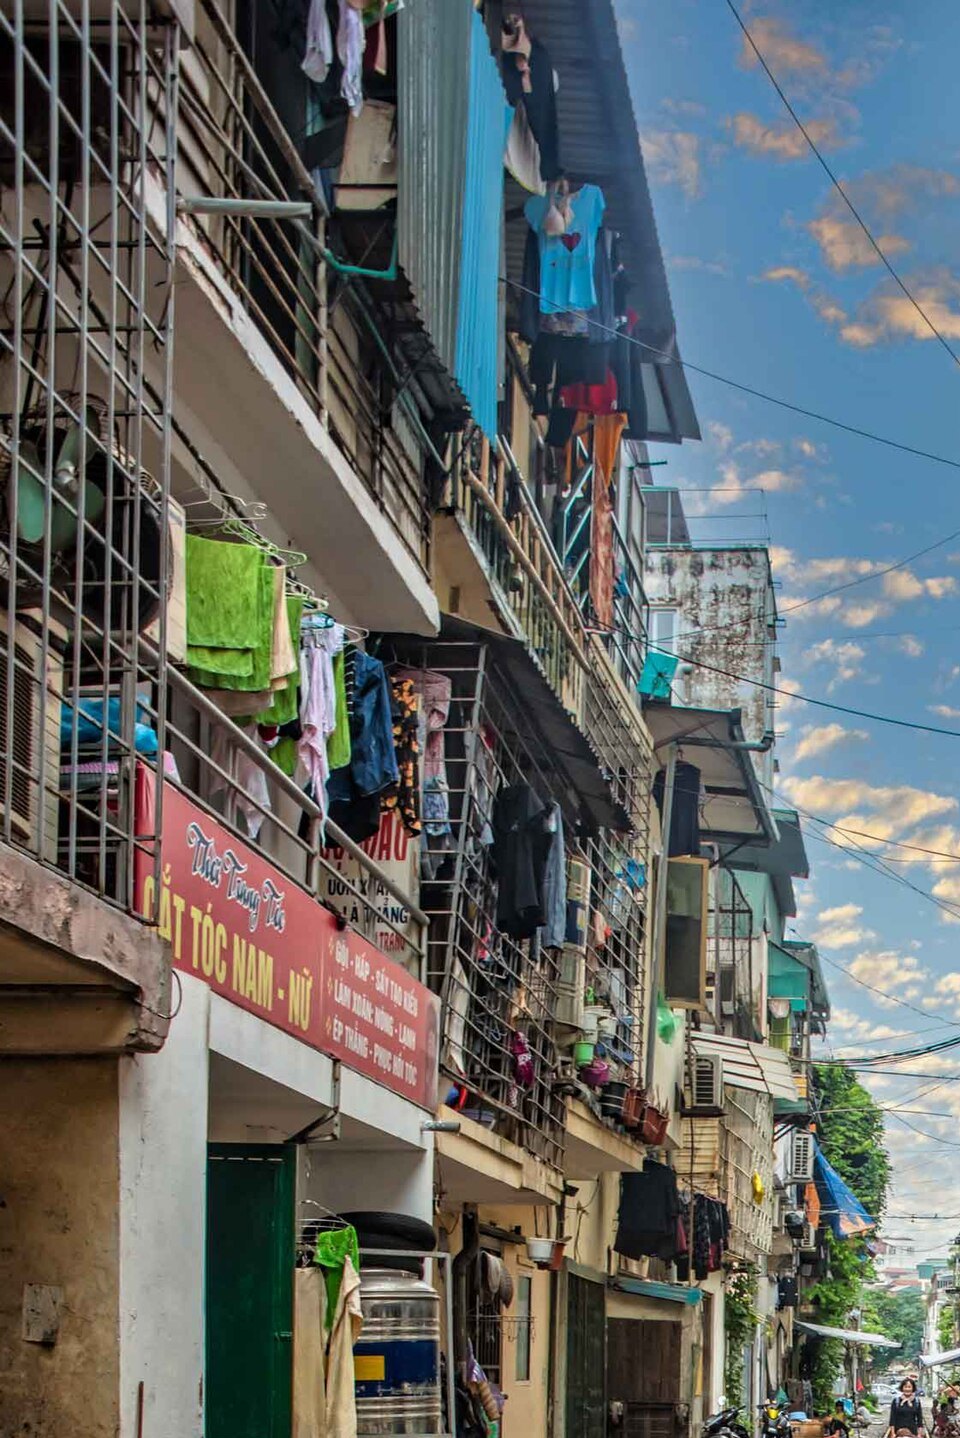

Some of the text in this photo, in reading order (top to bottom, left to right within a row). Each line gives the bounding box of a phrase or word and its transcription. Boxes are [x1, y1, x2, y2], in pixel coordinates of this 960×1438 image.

[191, 902, 228, 985] TÓC
[232, 933, 274, 1012] NAM
[288, 966, 313, 1032] NỮ
